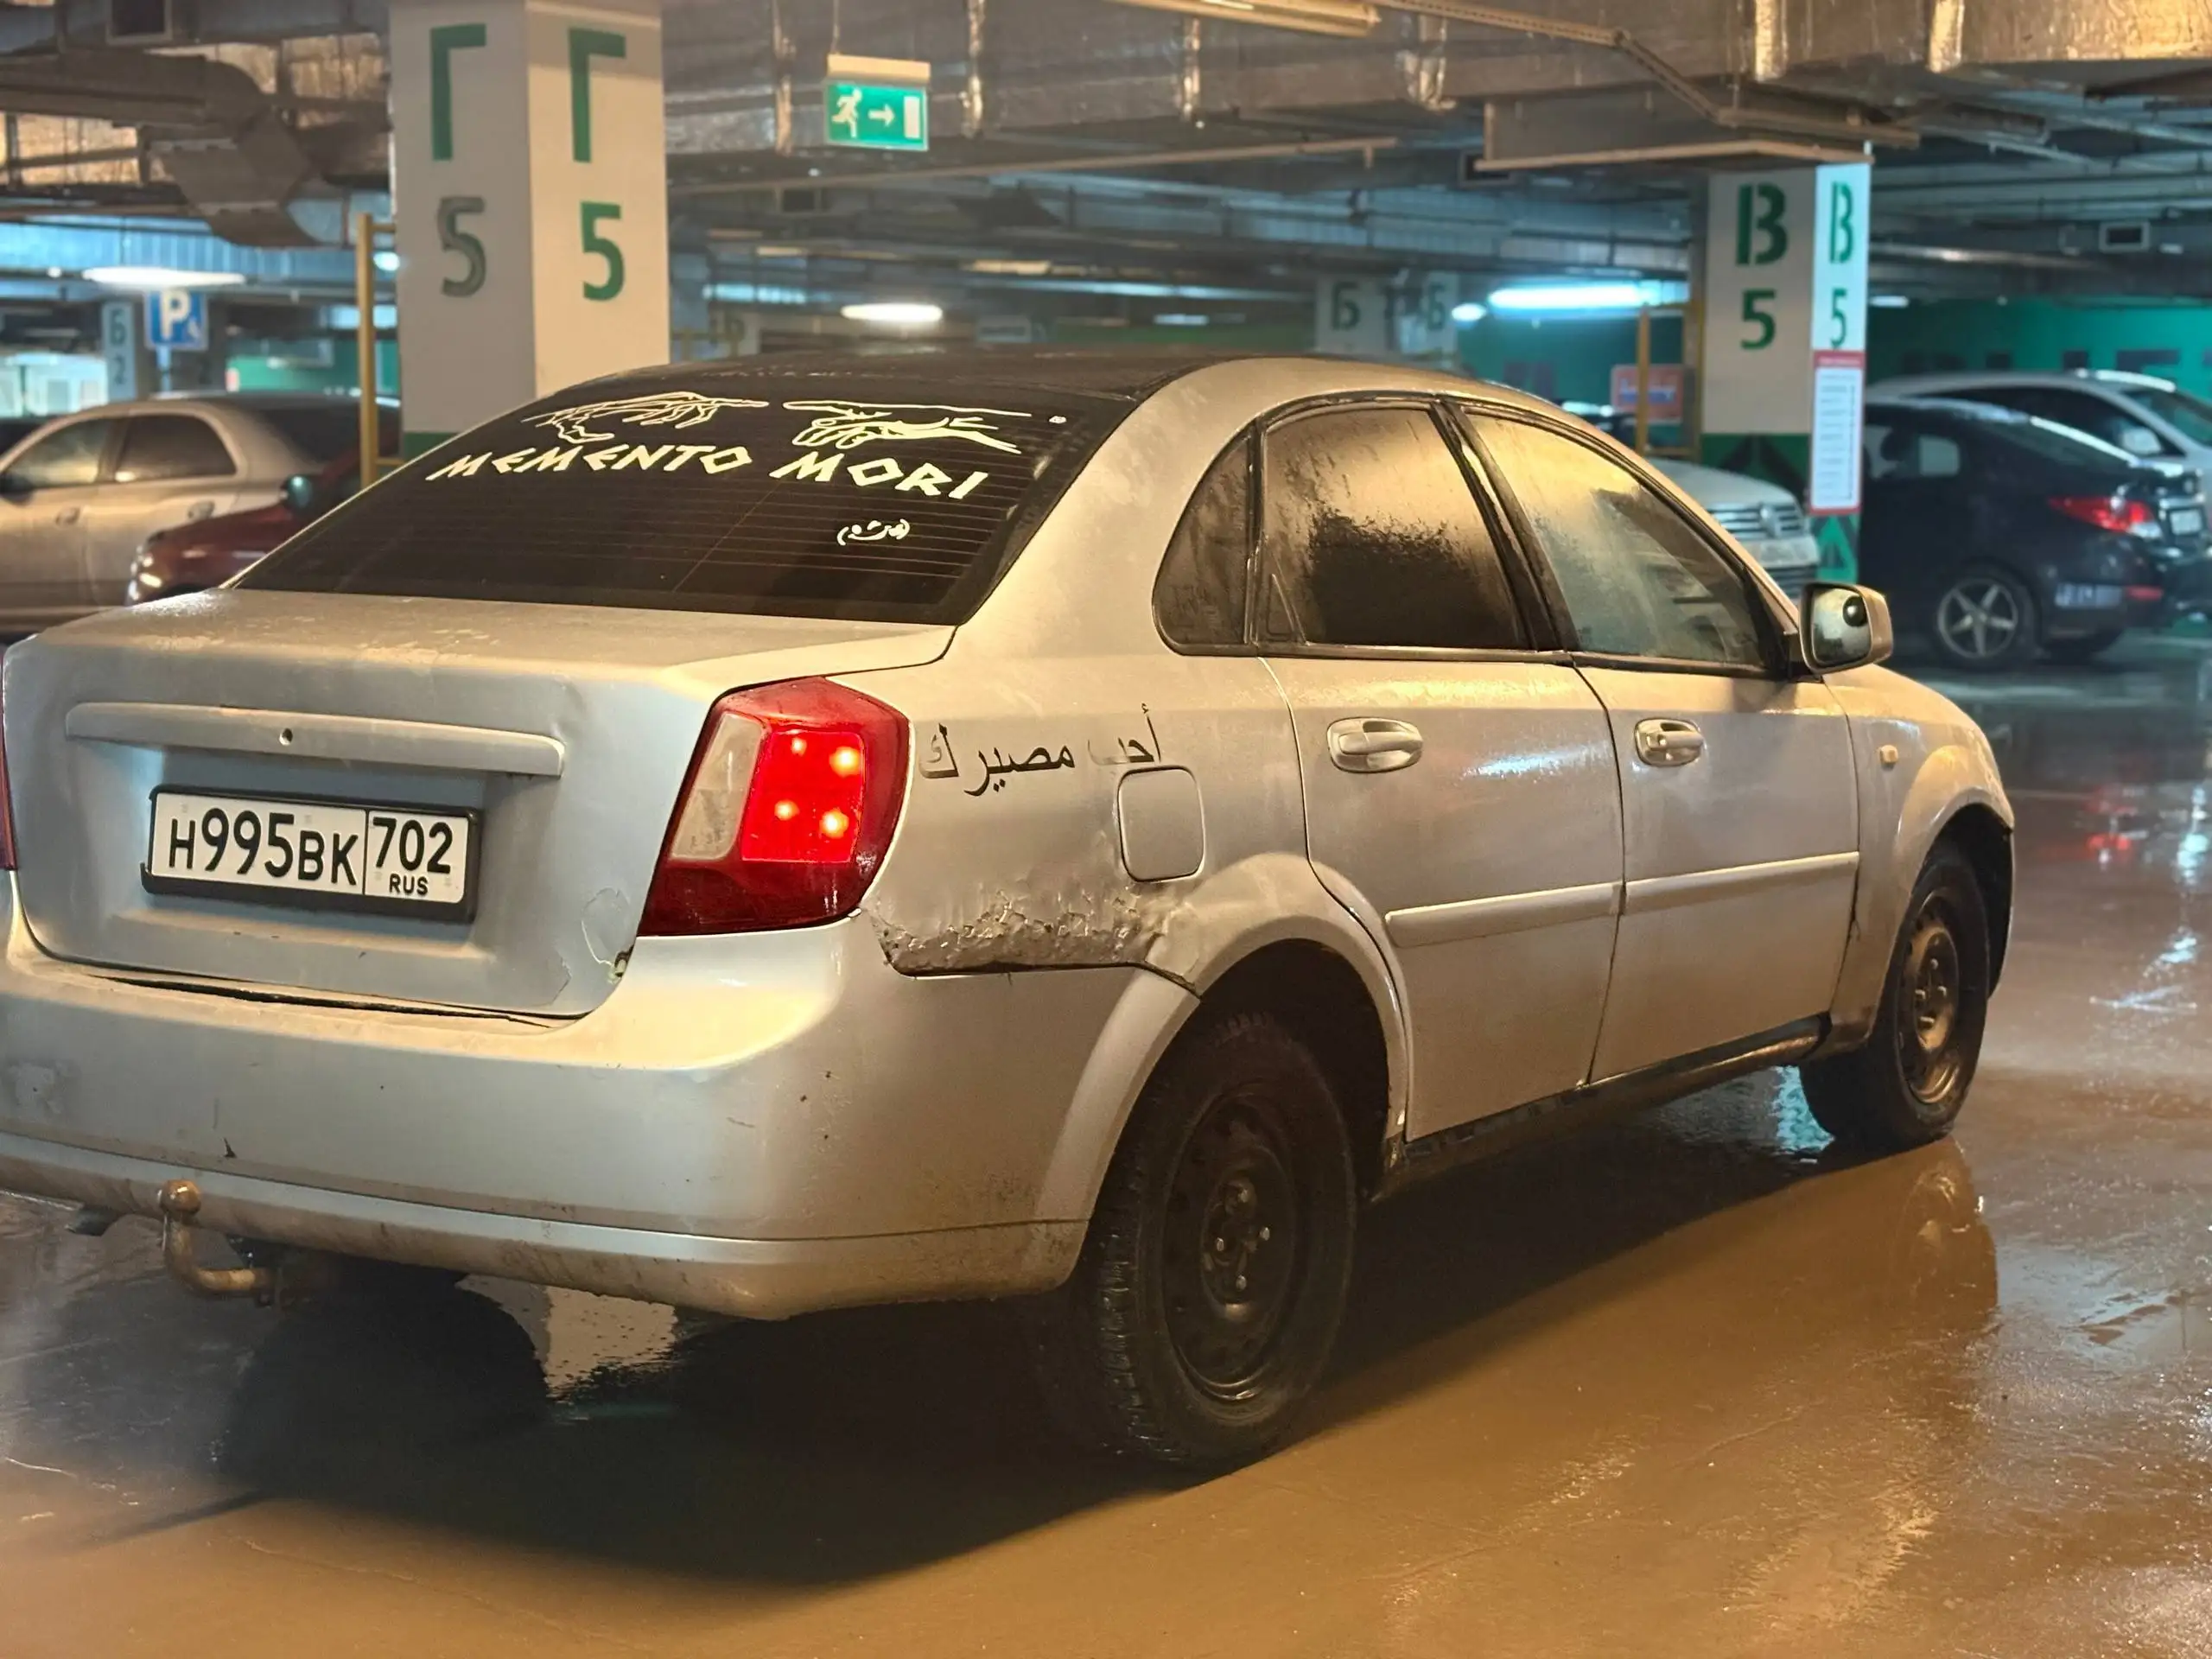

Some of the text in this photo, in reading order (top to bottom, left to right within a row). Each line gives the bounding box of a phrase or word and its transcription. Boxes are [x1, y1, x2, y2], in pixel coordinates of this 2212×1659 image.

[429, 23, 486, 162] Г
[568, 28, 626, 163] Г
[436, 196, 486, 298] 5
[580, 201, 626, 302] 5
[1738, 289, 1777, 350] 5
[1830, 287, 1848, 348] 5
[425, 443, 989, 499] MEMENTO MORI
[372, 816, 454, 875] 702
[389, 874, 429, 896] RUS
